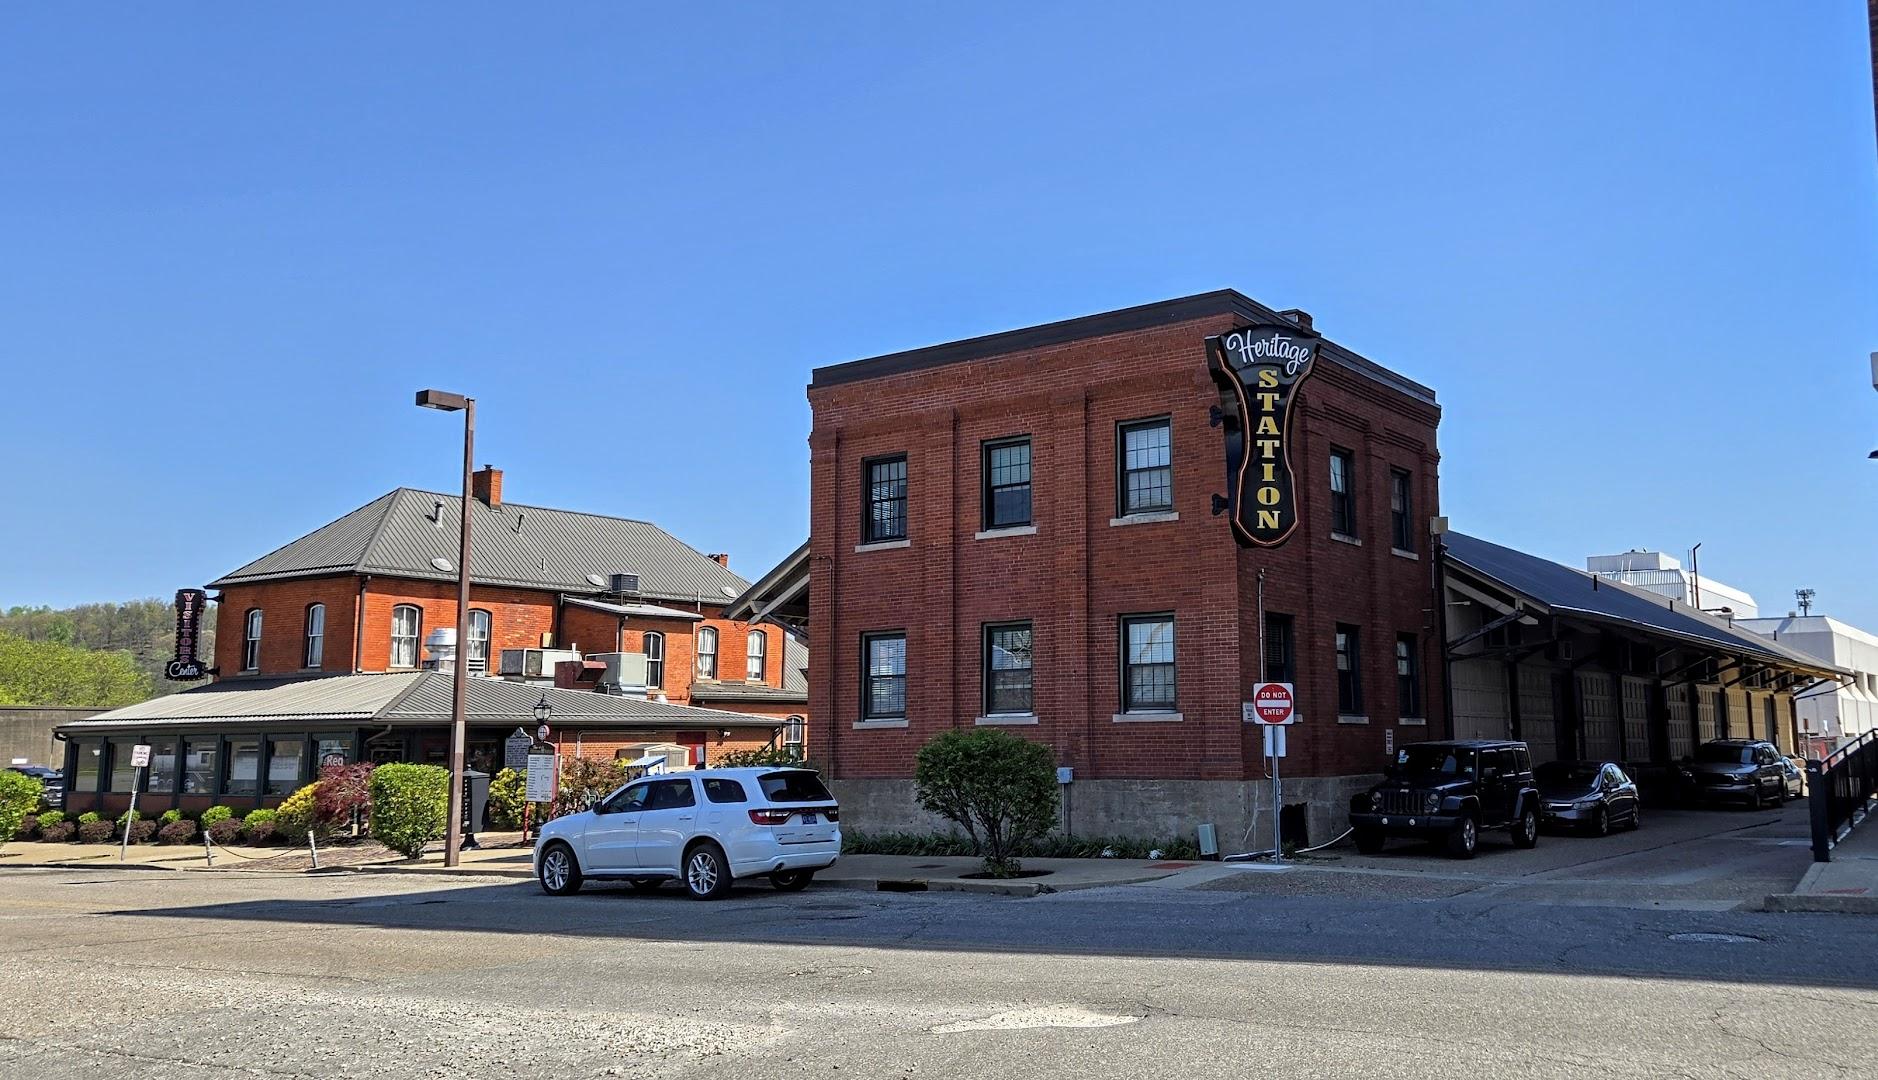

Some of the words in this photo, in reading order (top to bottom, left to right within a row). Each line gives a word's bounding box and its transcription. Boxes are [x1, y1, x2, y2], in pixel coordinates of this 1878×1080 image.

[1226, 330, 1309, 375] Heritage
[1256, 369, 1281, 529] STATION
[179, 593, 195, 664] VISITORS
[169, 661, 199, 677] Center
[1261, 691, 1270, 699] DO
[1272, 691, 1287, 699] NOT
[1263, 708, 1284, 716] ENTER
